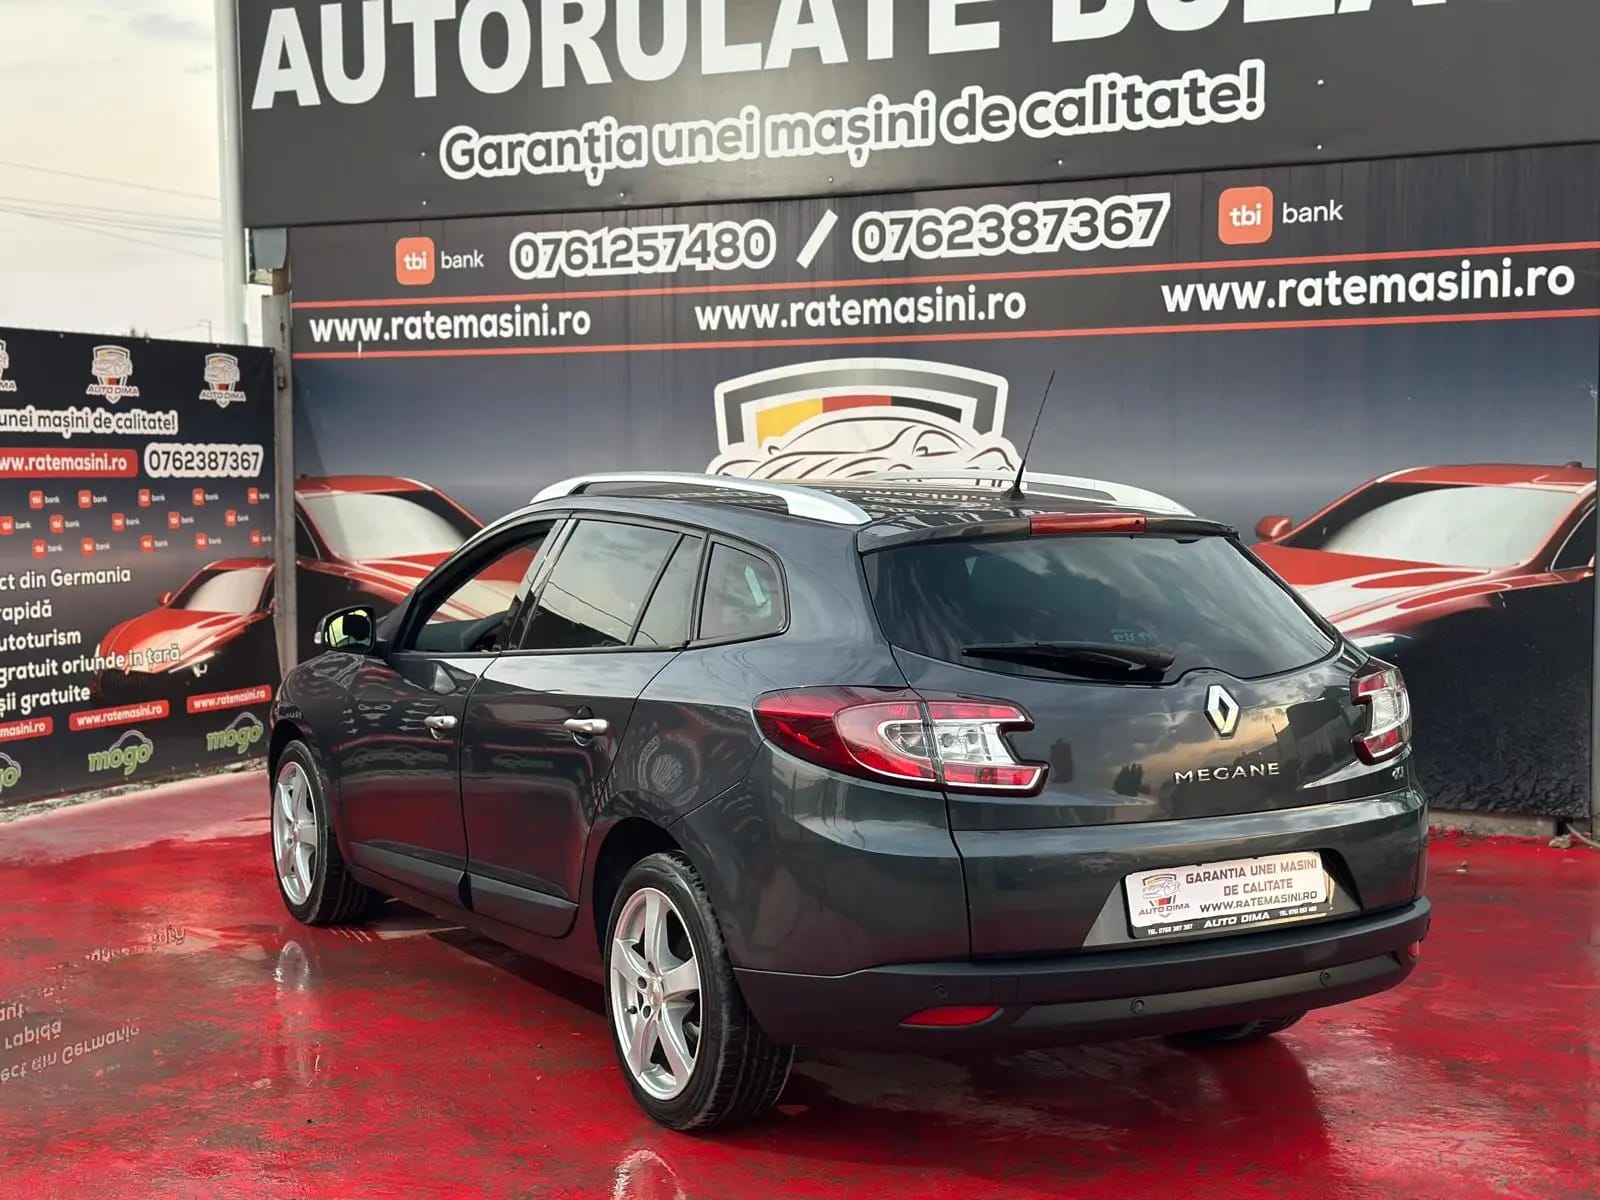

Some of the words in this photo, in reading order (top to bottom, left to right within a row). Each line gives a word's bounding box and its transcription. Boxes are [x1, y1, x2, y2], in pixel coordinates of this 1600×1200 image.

[442, 119, 646, 183] Garanția
[655, 109, 758, 162] unei
[767, 94, 933, 164] mașini
[942, 89, 1014, 139] de
[1022, 64, 1261, 134] calitate!
[1229, 202, 1263, 228] tbi
[1282, 199, 1344, 225] bank
[511, 221, 775, 277] 0761257480
[853, 196, 1169, 260] 0762387367
[402, 251, 428, 271] tbi
[440, 249, 485, 270] bank
[1161, 256, 1576, 313] www.ratemasini.ro
[694, 284, 1027, 331] www.ratemasini.ro
[310, 302, 591, 344] www.ratemasini.ro
[87, 386, 114, 394] AUTO
[115, 386, 138, 395] DIMA
[200, 391, 223, 400] AUTO
[224, 392, 245, 401] DIMA
[37, 410, 89, 433] mașini
[93, 413, 112, 429] de
[115, 414, 176, 431] calitate!
[149, 450, 261, 472] 0762387367
[20, 570, 46, 589] din
[50, 565, 131, 587] Germania
[61, 651, 126, 674] oriunde
[20, 684, 92, 716] gratuite
[193, 688, 266, 709] www.ratemasini.ro
[77, 704, 163, 727] www.ratemasini.ro
[206, 725, 262, 755] mogo
[88, 743, 152, 776] mogo
[1174, 762, 1281, 785] MEGANE
[1185, 867, 1247, 884] GARANTIA
[1250, 863, 1277, 876] UNEI
[1280, 858, 1317, 873] MASINI
[1223, 885, 1239, 897] DE
[1243, 878, 1293, 894] CALITATE
[1138, 906, 1165, 917] AUTO
[1166, 902, 1190, 912] DIMA
[1199, 890, 1318, 913] WWW.RATEMASINI.RO
[1203, 917, 1238, 929] AUTO
[1240, 911, 1270, 924] DIMA
